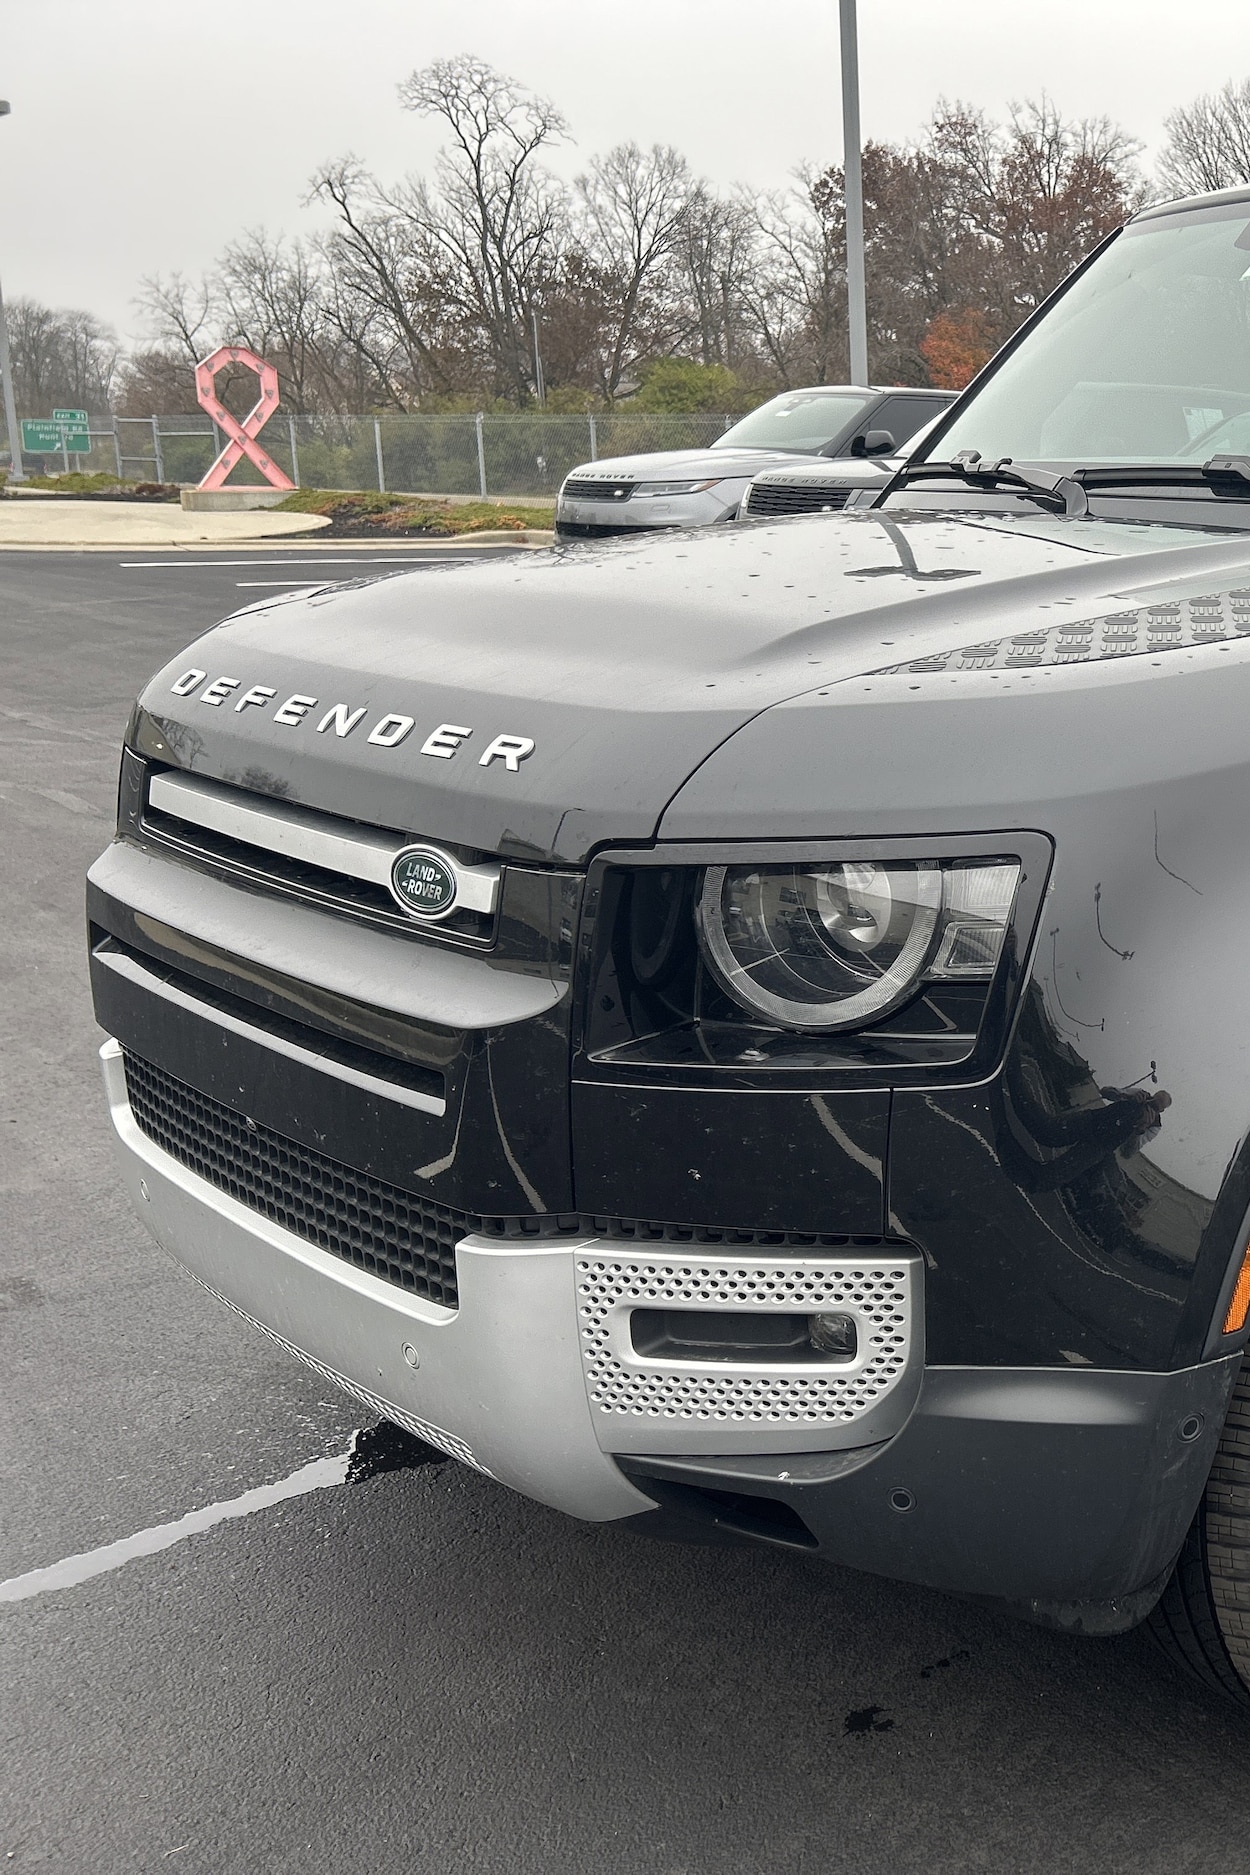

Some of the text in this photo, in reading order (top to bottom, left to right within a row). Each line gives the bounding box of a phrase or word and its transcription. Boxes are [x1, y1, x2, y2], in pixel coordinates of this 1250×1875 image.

[27, 423, 69, 432] Plainfied
[170, 667, 537, 772] DEFENDER
[406, 862, 436, 882] LAND
[406, 879, 443, 900] ROVER
